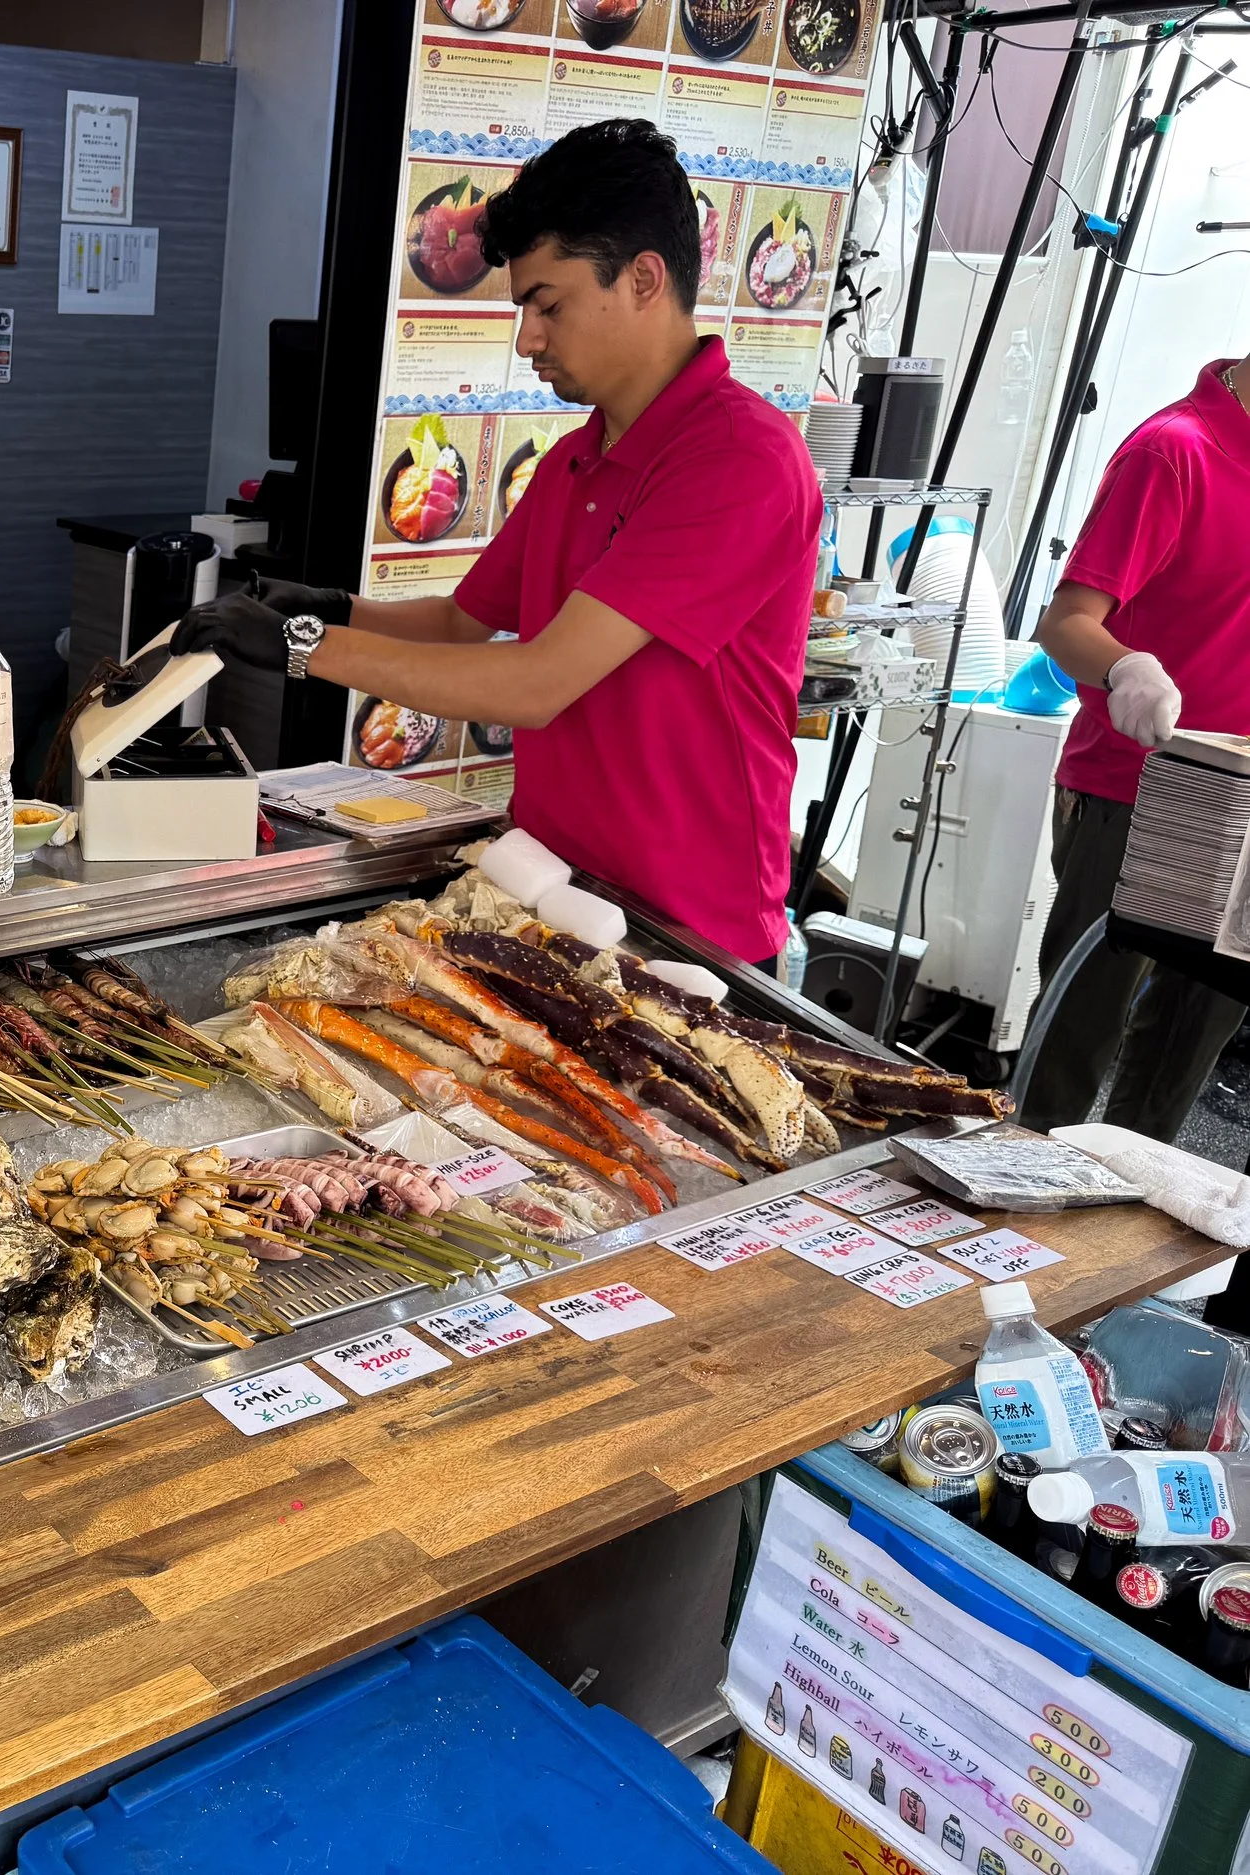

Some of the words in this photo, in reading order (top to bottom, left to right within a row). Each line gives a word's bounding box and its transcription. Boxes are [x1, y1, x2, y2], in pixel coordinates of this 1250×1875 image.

[436, 1149, 497, 1175] HALF-SIZE
[809, 1181, 842, 1195] KING
[841, 1172, 869, 1186] CRAB
[735, 1208, 768, 1224] KING
[768, 1197, 803, 1213] CRAB
[865, 1209, 902, 1225] KING
[903, 1200, 940, 1217] CRAB
[887, 1211, 953, 1236] ¥8000
[799, 1235, 832, 1251] CRAB
[814, 1236, 876, 1259] ¥6000
[952, 1241, 988, 1258] BUY
[987, 1237, 1002, 1246] 2
[849, 1268, 884, 1285] KING
[879, 1254, 920, 1271] CRAB
[974, 1252, 1001, 1266] GET
[1002, 1257, 1030, 1273] OFF
[871, 1266, 935, 1297] ¥7000
[549, 1297, 587, 1315] COKE
[559, 1302, 608, 1323] WATER
[333, 1334, 394, 1363] SHRIMP
[233, 1385, 292, 1412] SMALL
[988, 1402, 1035, 1421] 天然水
[1174, 1470, 1197, 1524] 天然水
[1217, 1483, 1228, 1510] 500ml
[1096, 1504, 1138, 1526] KIRIN
[815, 1547, 849, 1579] Beer
[865, 1582, 911, 1619] ビール
[808, 1577, 840, 1608] Cola
[856, 1610, 901, 1647] コーラ
[801, 1605, 844, 1644] Water
[848, 1640, 866, 1660] 水
[784, 1661, 841, 1713] Highball
[791, 1633, 840, 1678] Lemon
[842, 1670, 875, 1702] Sour
[899, 1711, 998, 1788] レモンサワー
